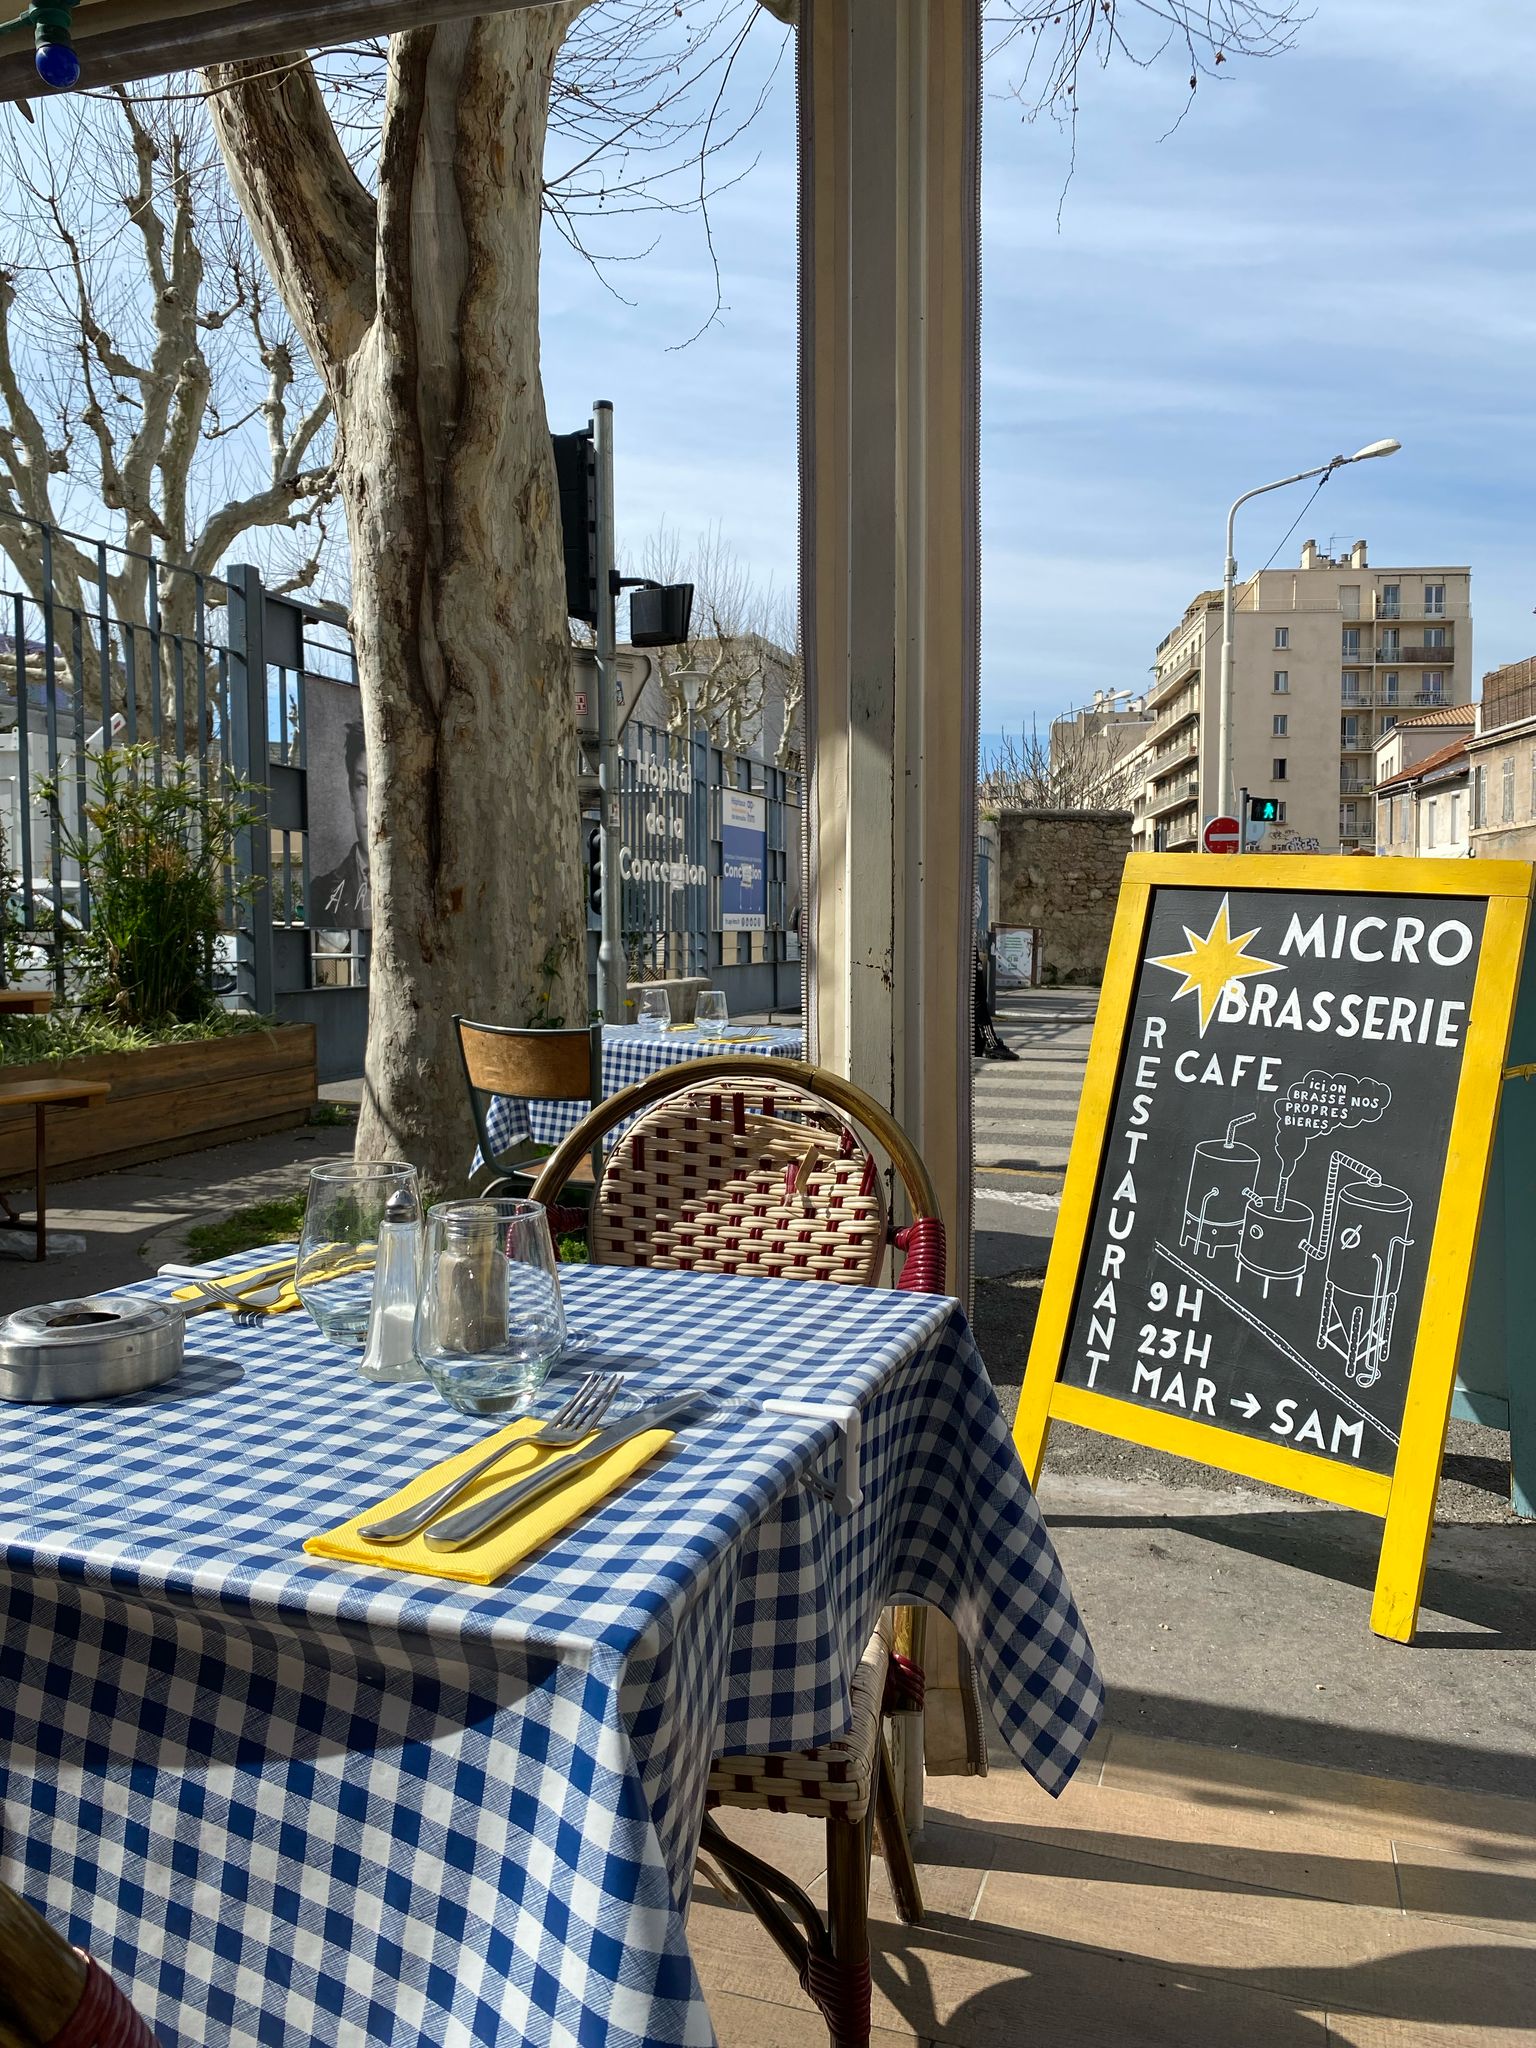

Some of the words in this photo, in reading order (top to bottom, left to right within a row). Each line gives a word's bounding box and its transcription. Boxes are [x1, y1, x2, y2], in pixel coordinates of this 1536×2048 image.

[636, 748, 692, 798] Hôpital
[669, 806, 684, 839] la
[620, 846, 707, 888] Conceion
[723, 862, 762, 881] Concion
[1279, 912, 1473, 967] MICRO
[1217, 977, 1466, 1048] BRASSERIE
[1174, 1049, 1283, 1092] CAFE
[1285, 1101, 1349, 1120] PROPRES
[1293, 1089, 1346, 1105] BRASSE
[1350, 1096, 1380, 1109] NOS
[1086, 1016, 1167, 1389] RESTAURANT
[1137, 1324, 1213, 1370] 23H
[1131, 1359, 1217, 1417] MAR
[1269, 1398, 1365, 1459] SAM
